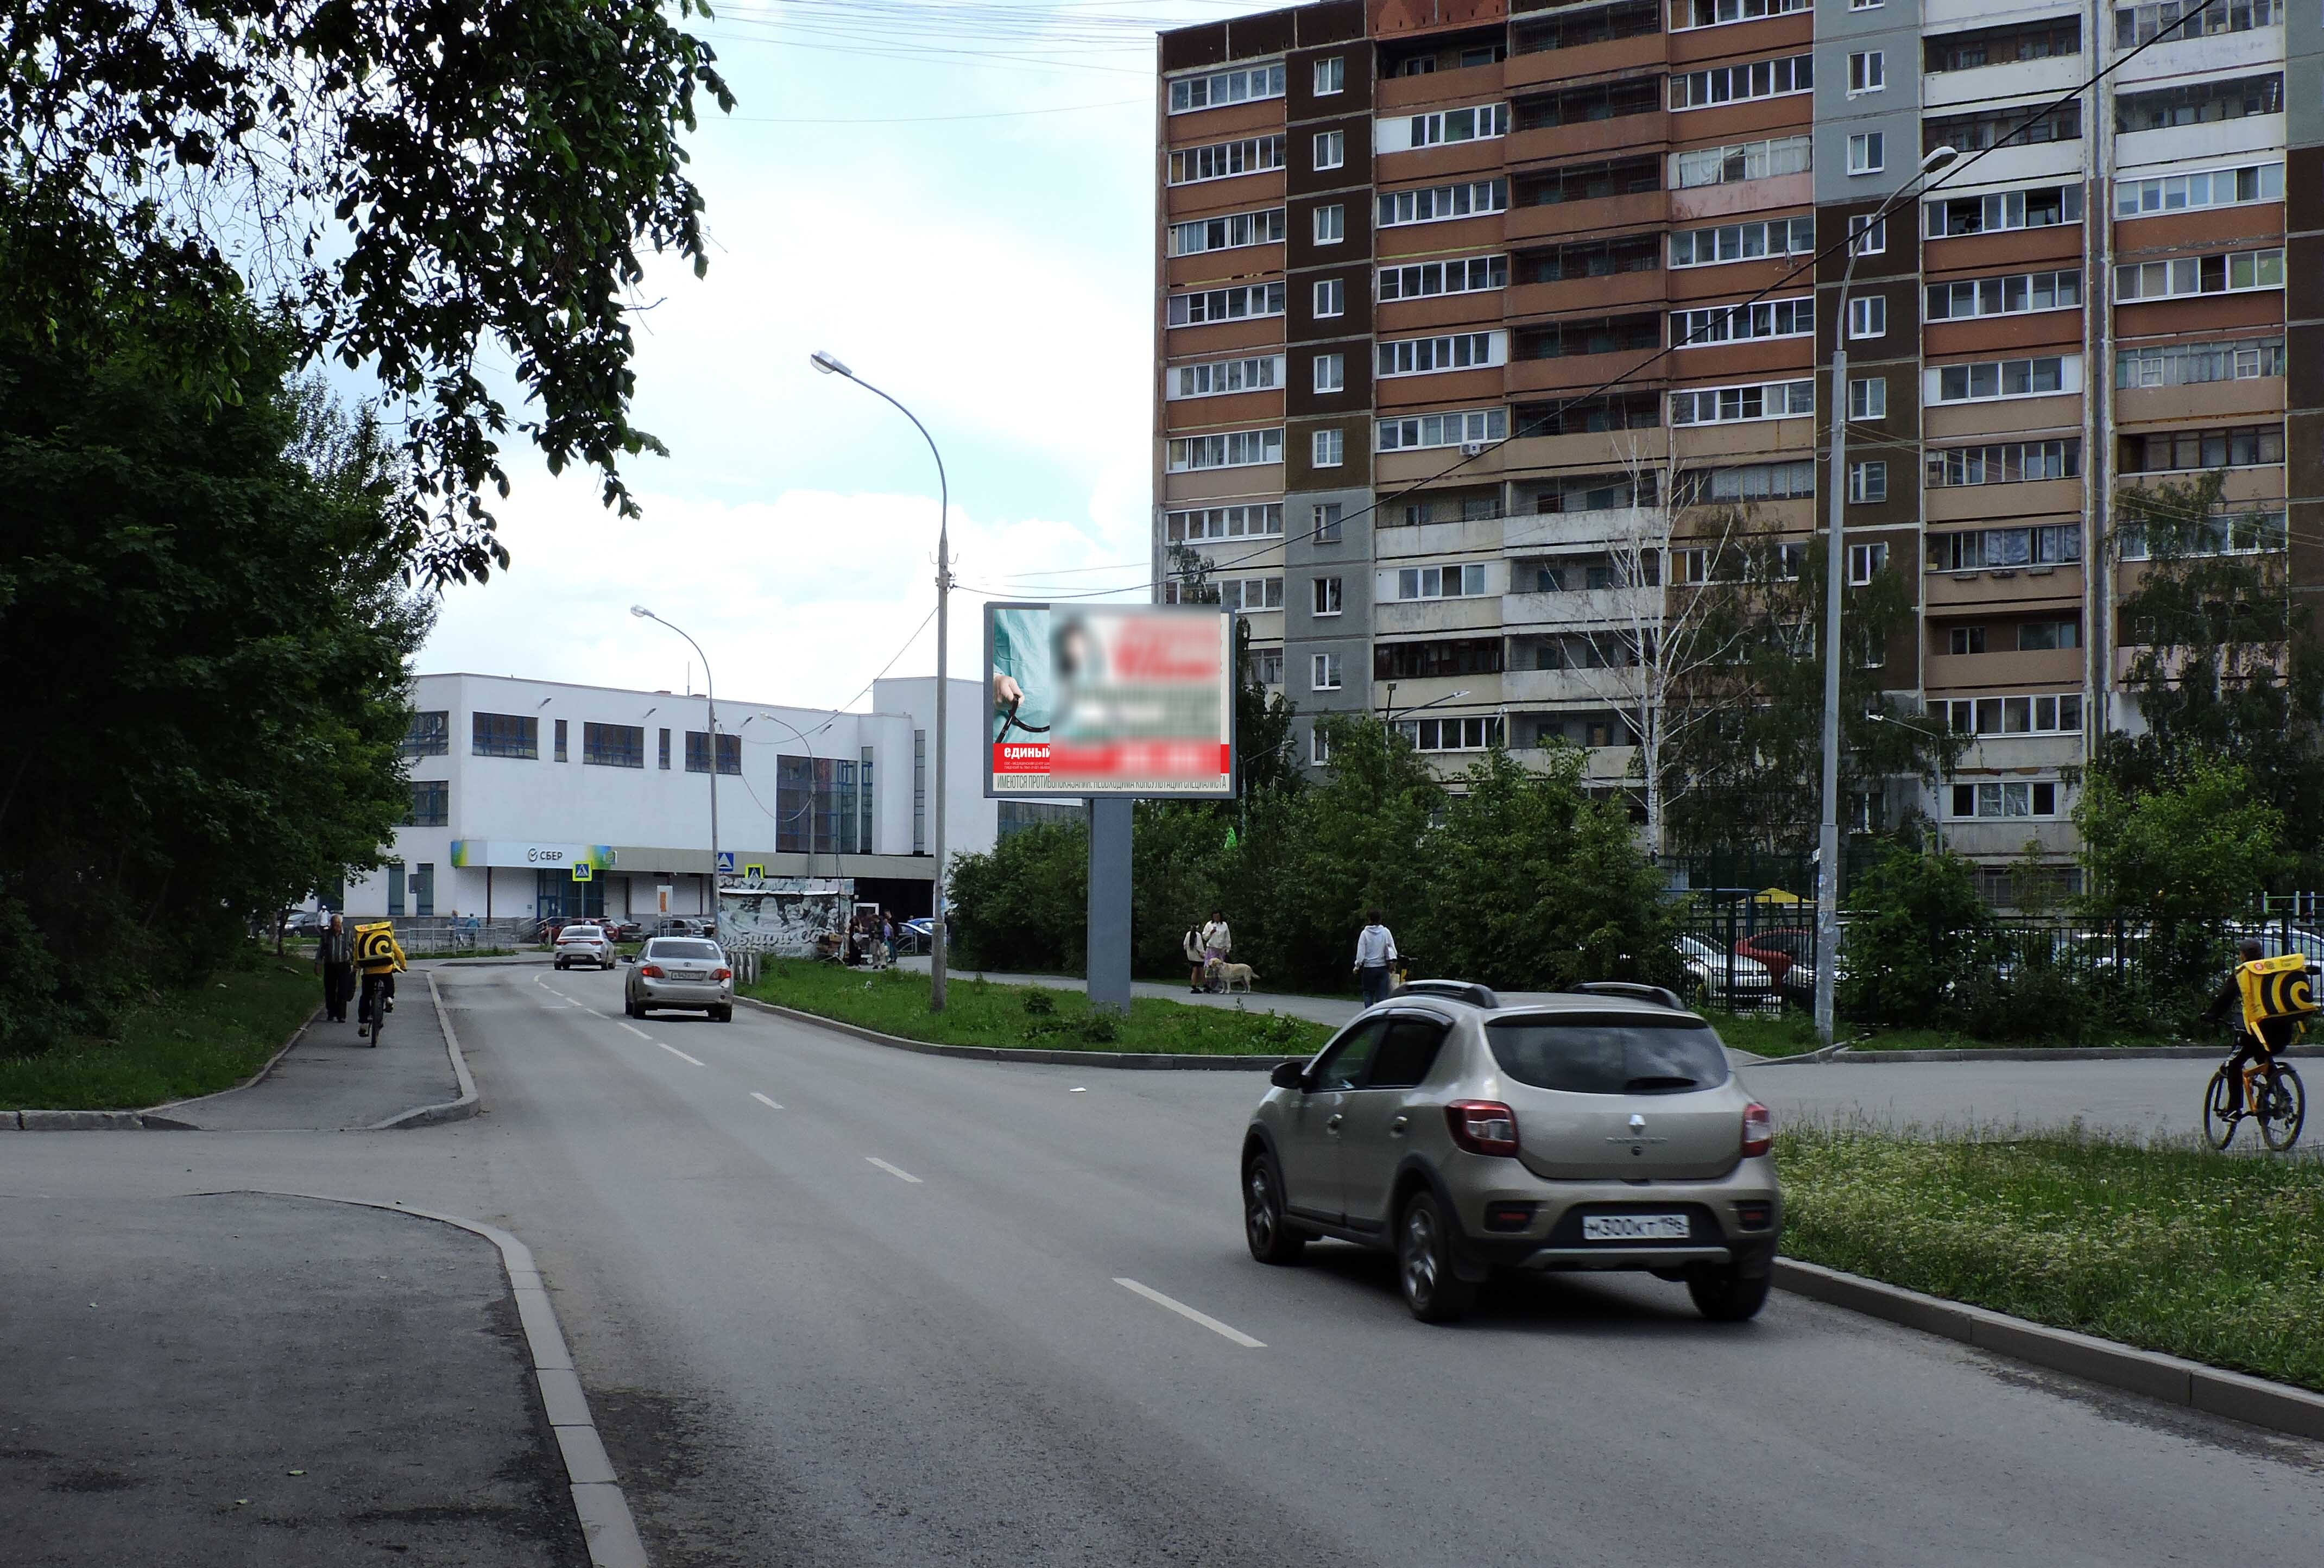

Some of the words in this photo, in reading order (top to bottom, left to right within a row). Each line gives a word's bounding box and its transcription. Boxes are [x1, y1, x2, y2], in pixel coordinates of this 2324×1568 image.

[1004, 745, 1050, 760] единый
[997, 775, 1027, 788] ИМЕЮТСЯ
[540, 851, 563, 861] СБЕР
